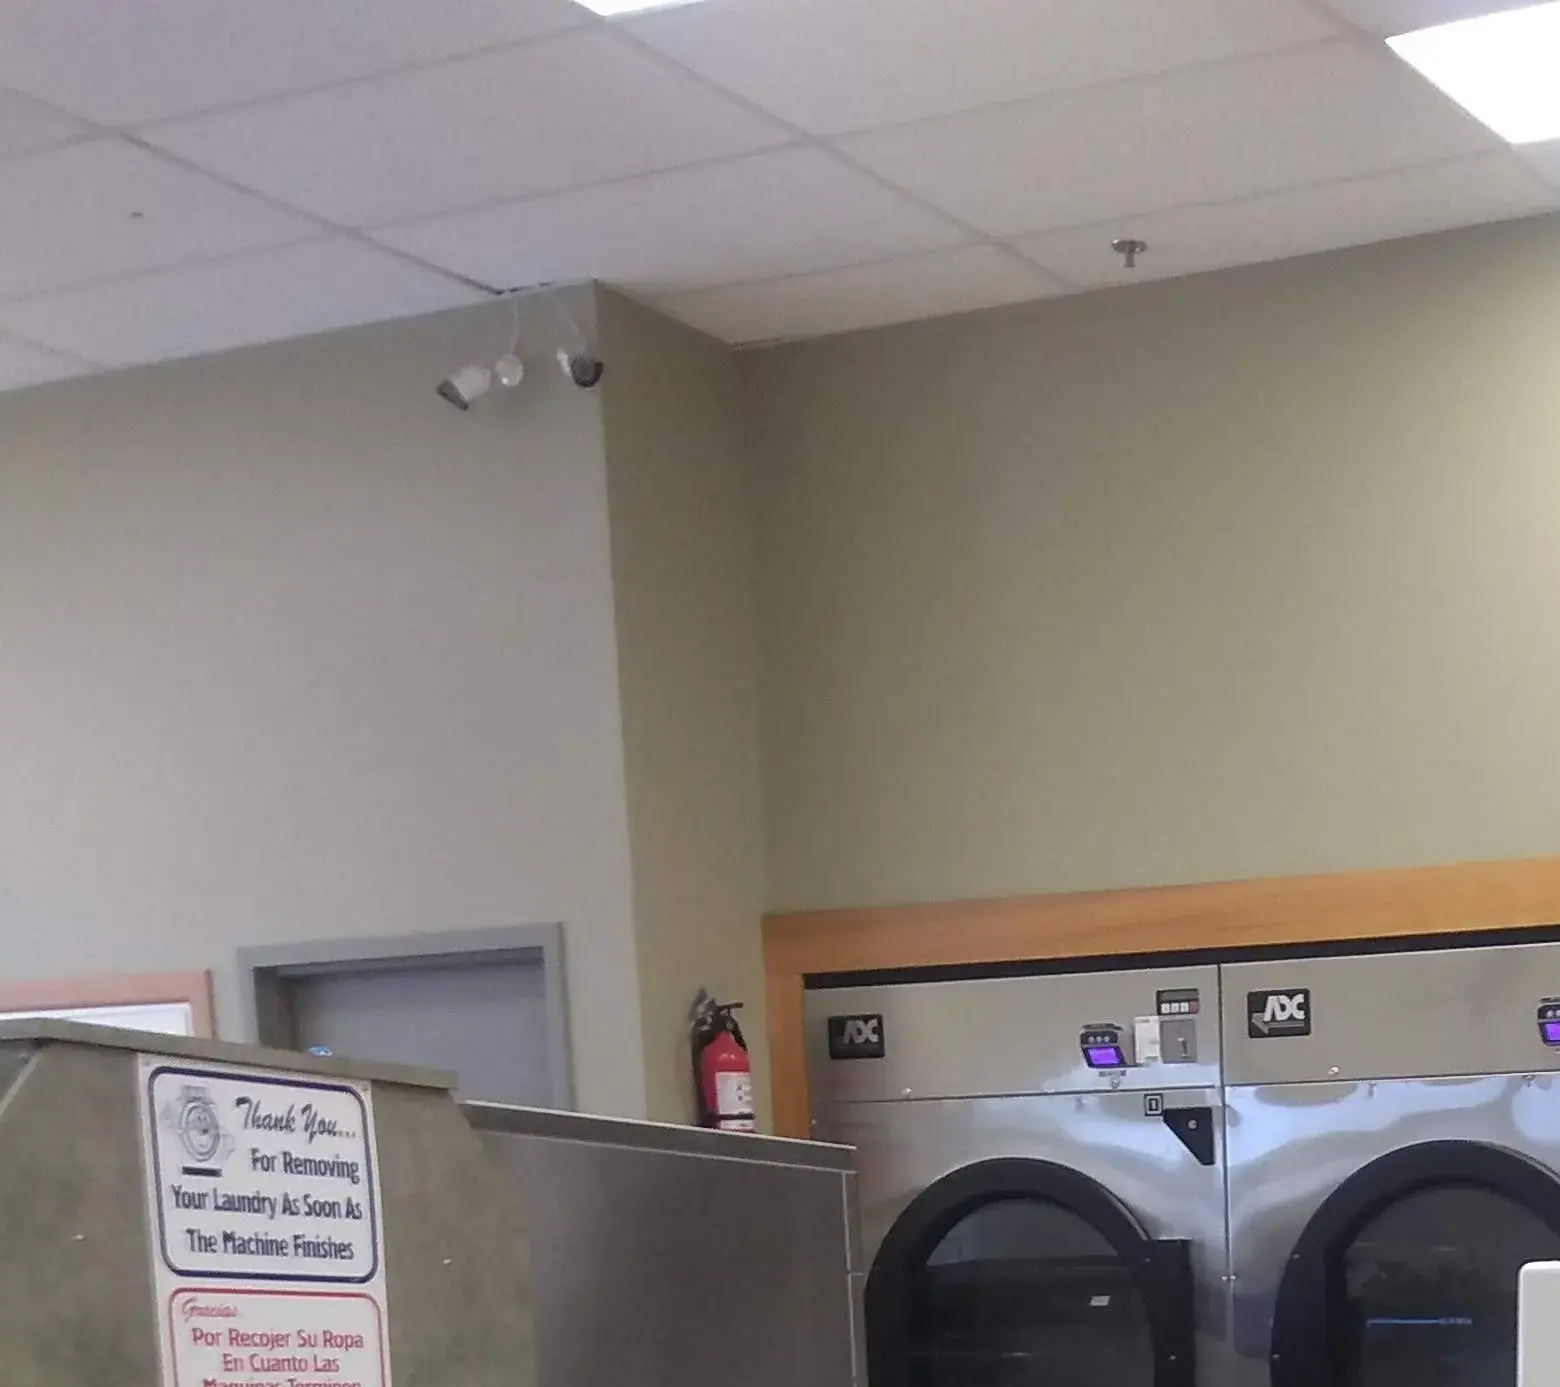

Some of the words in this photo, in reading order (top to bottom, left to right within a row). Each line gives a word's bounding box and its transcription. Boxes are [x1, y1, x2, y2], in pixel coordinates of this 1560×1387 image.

[1264, 993, 1305, 1021] ADC
[844, 1019, 878, 1044] ADC
[236, 1096, 297, 1133] Thank
[250, 1148, 277, 1172] For
[283, 1151, 361, 1184] Removing
[171, 1184, 209, 1209] Your
[213, 1187, 276, 1220] Laundry
[282, 1192, 300, 1216] As
[304, 1194, 342, 1218] Soon
[345, 1197, 363, 1220] As
[186, 1228, 218, 1253] The
[222, 1230, 289, 1257] Machine
[293, 1234, 355, 1260] Finishes
[192, 1327, 222, 1347] Por
[228, 1328, 291, 1350] Recojer
[297, 1329, 317, 1348] Su
[323, 1330, 364, 1352] Ropa
[222, 1353, 244, 1372] En
[250, 1353, 308, 1372] Cuanto
[313, 1354, 340, 1372] Las
